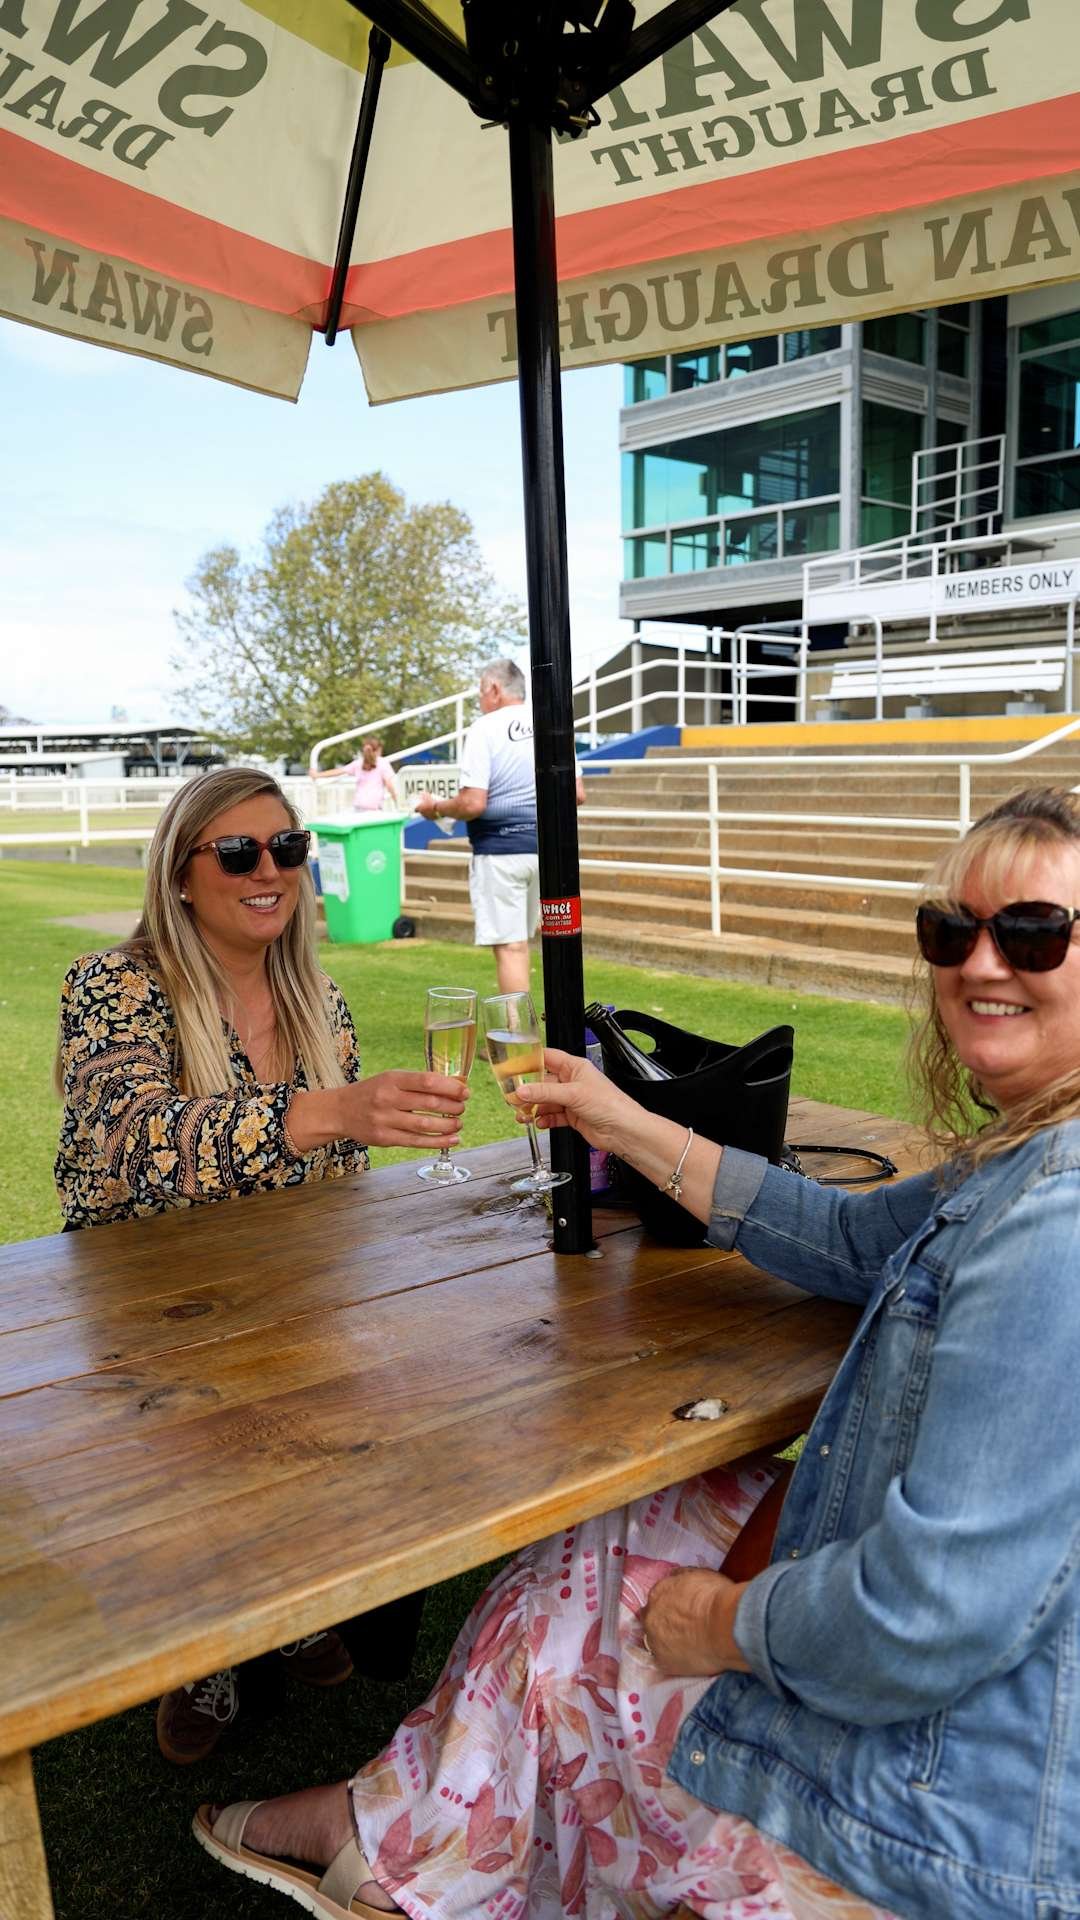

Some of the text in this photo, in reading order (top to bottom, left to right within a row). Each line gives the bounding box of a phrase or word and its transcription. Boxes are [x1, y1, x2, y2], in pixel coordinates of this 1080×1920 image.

[944, 569, 1074, 600] MEMBERS ONLY
[405, 779, 461, 800] MEMBE
